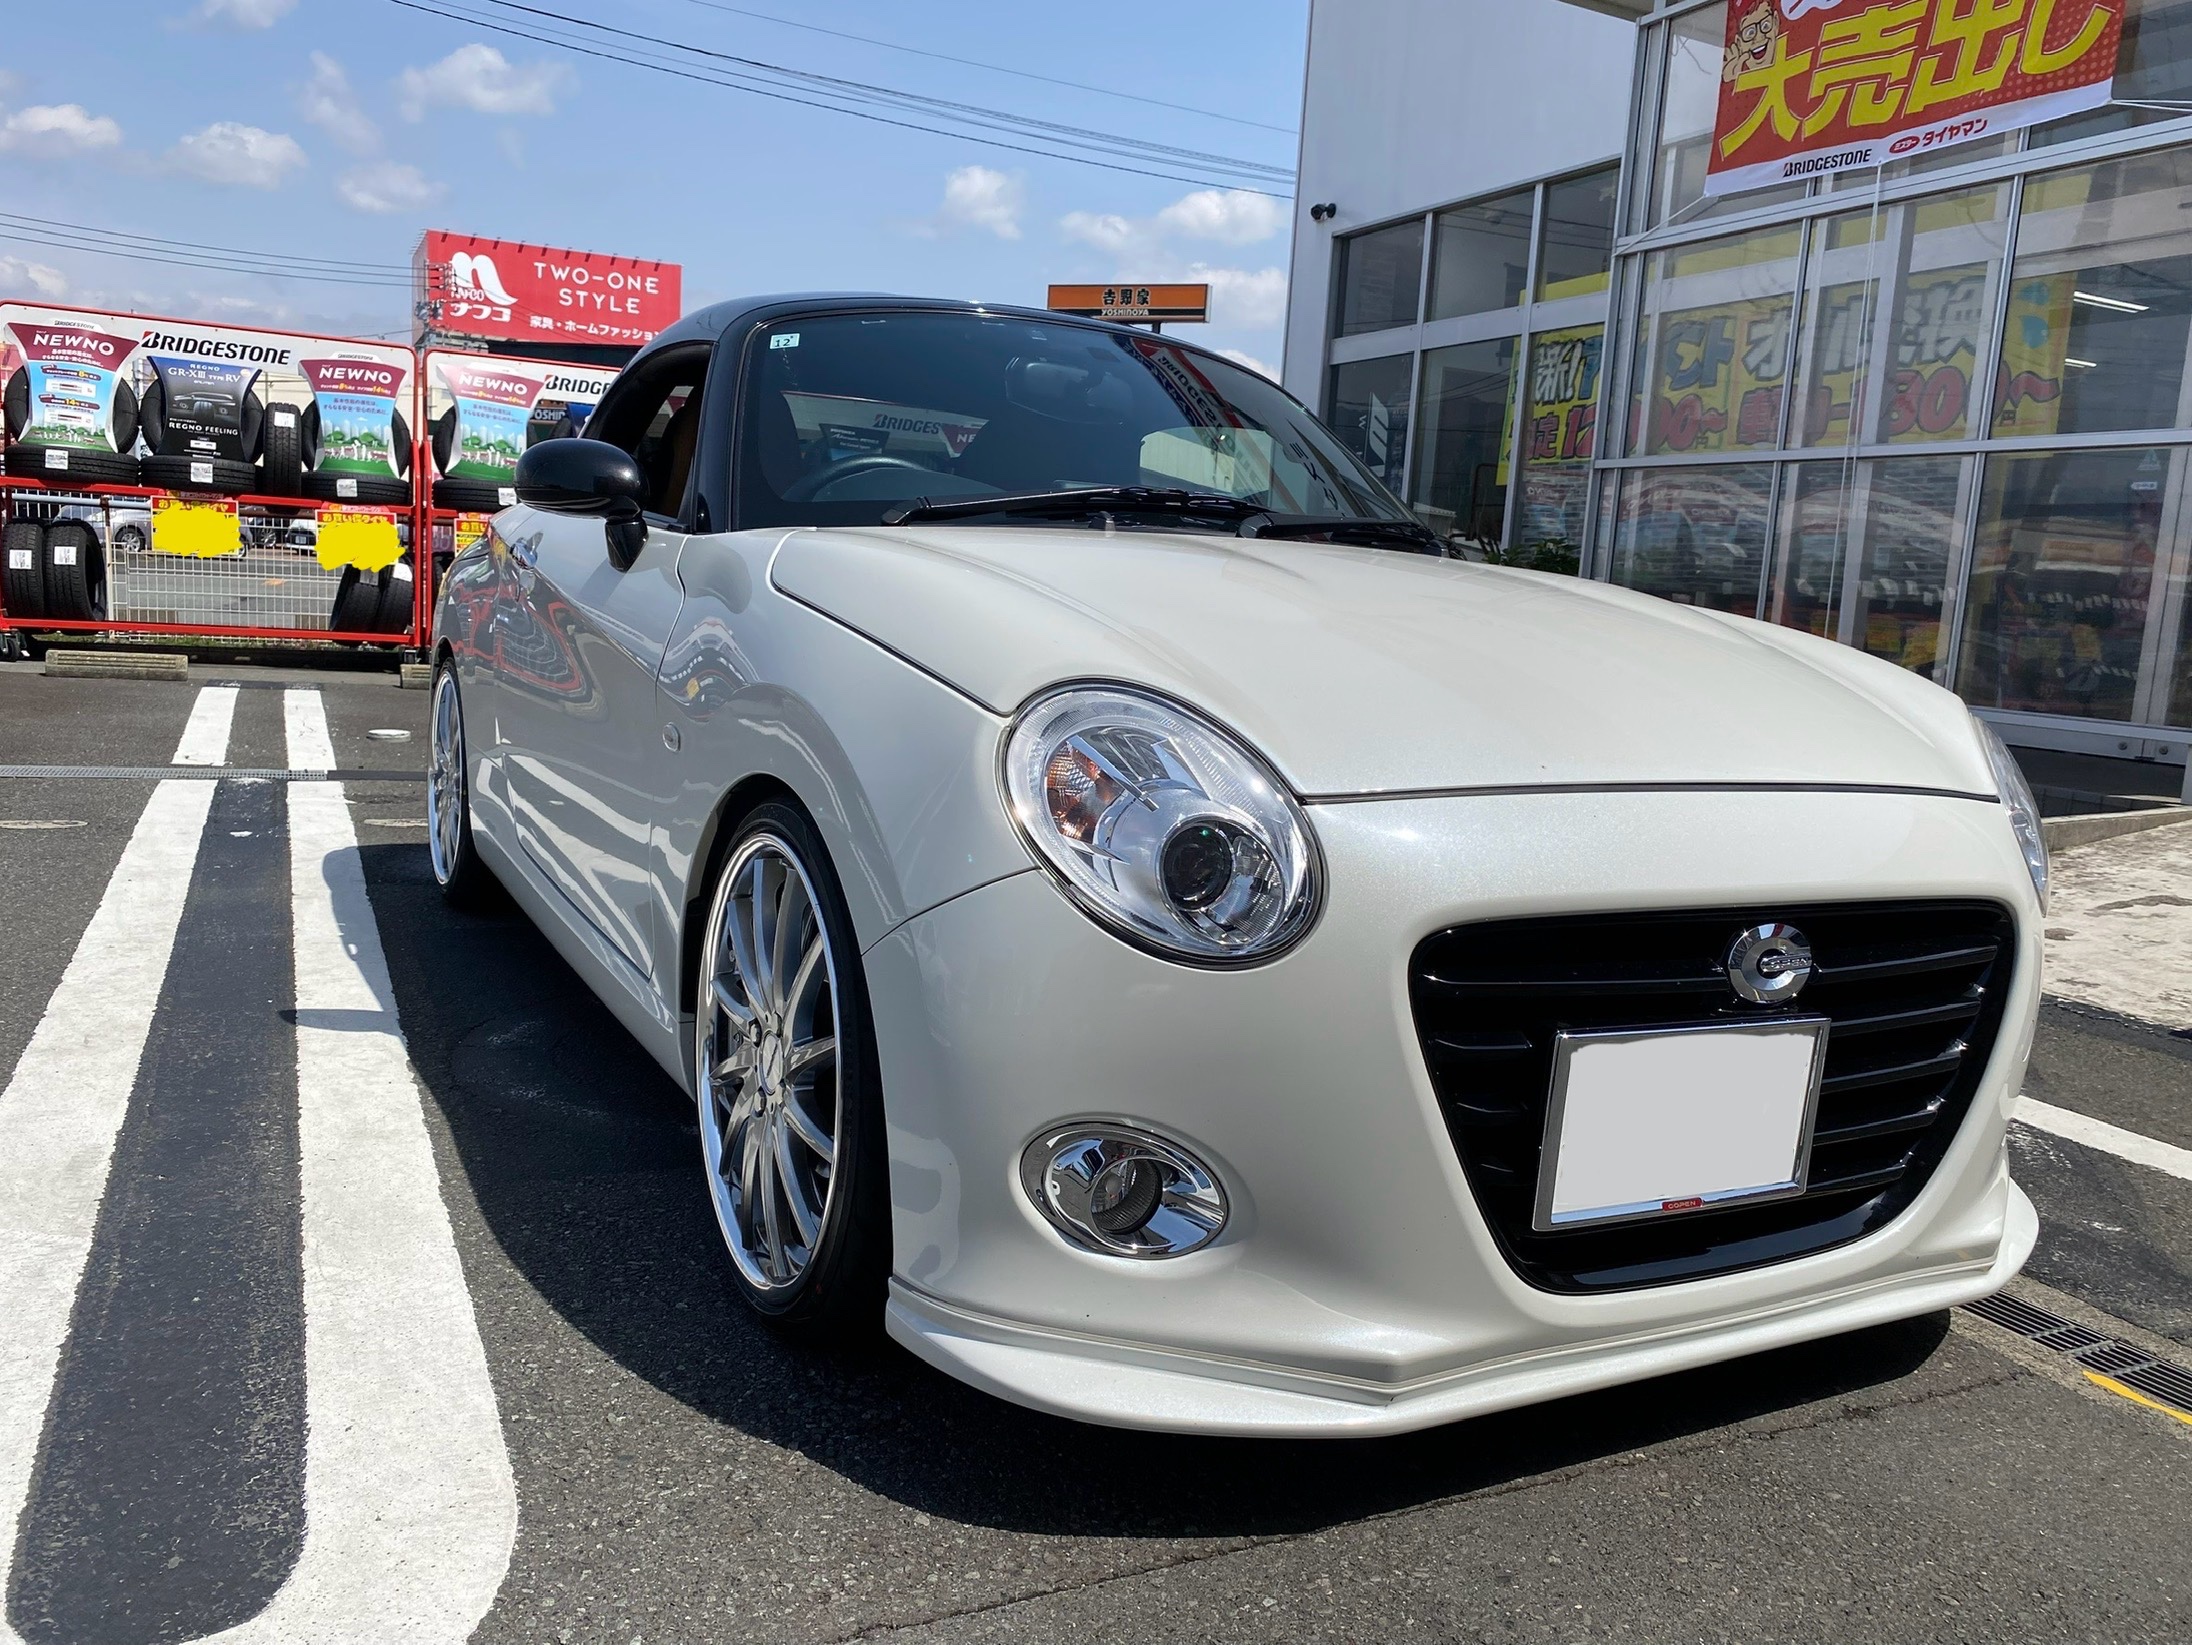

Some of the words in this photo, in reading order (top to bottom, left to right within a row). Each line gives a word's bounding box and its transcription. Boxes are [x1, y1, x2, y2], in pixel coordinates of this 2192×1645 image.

[1720, 0, 2115, 160] 大売出し
[1922, 118, 1988, 147] タイヤマン
[1783, 149, 1872, 178] BRIDGESTONE
[533, 262, 660, 295] TWO-ONE
[559, 287, 641, 315] STYLE
[1102, 287, 1150, 307] 吉野家
[450, 301, 512, 323] ナフコ
[1101, 308, 1149, 316] YOSHINOYA
[33, 333, 115, 356] NEWNO
[141, 330, 291, 365] BRIDGESTONE
[190, 363, 220, 372] REGNO
[226, 373, 241, 383] RV
[319, 367, 392, 384] NEWNO
[459, 373, 528, 396] NEWNO
[169, 421, 203, 431] REGNO
[205, 425, 239, 436] FEELING
[1667, 1200, 1697, 1210] COPEN
